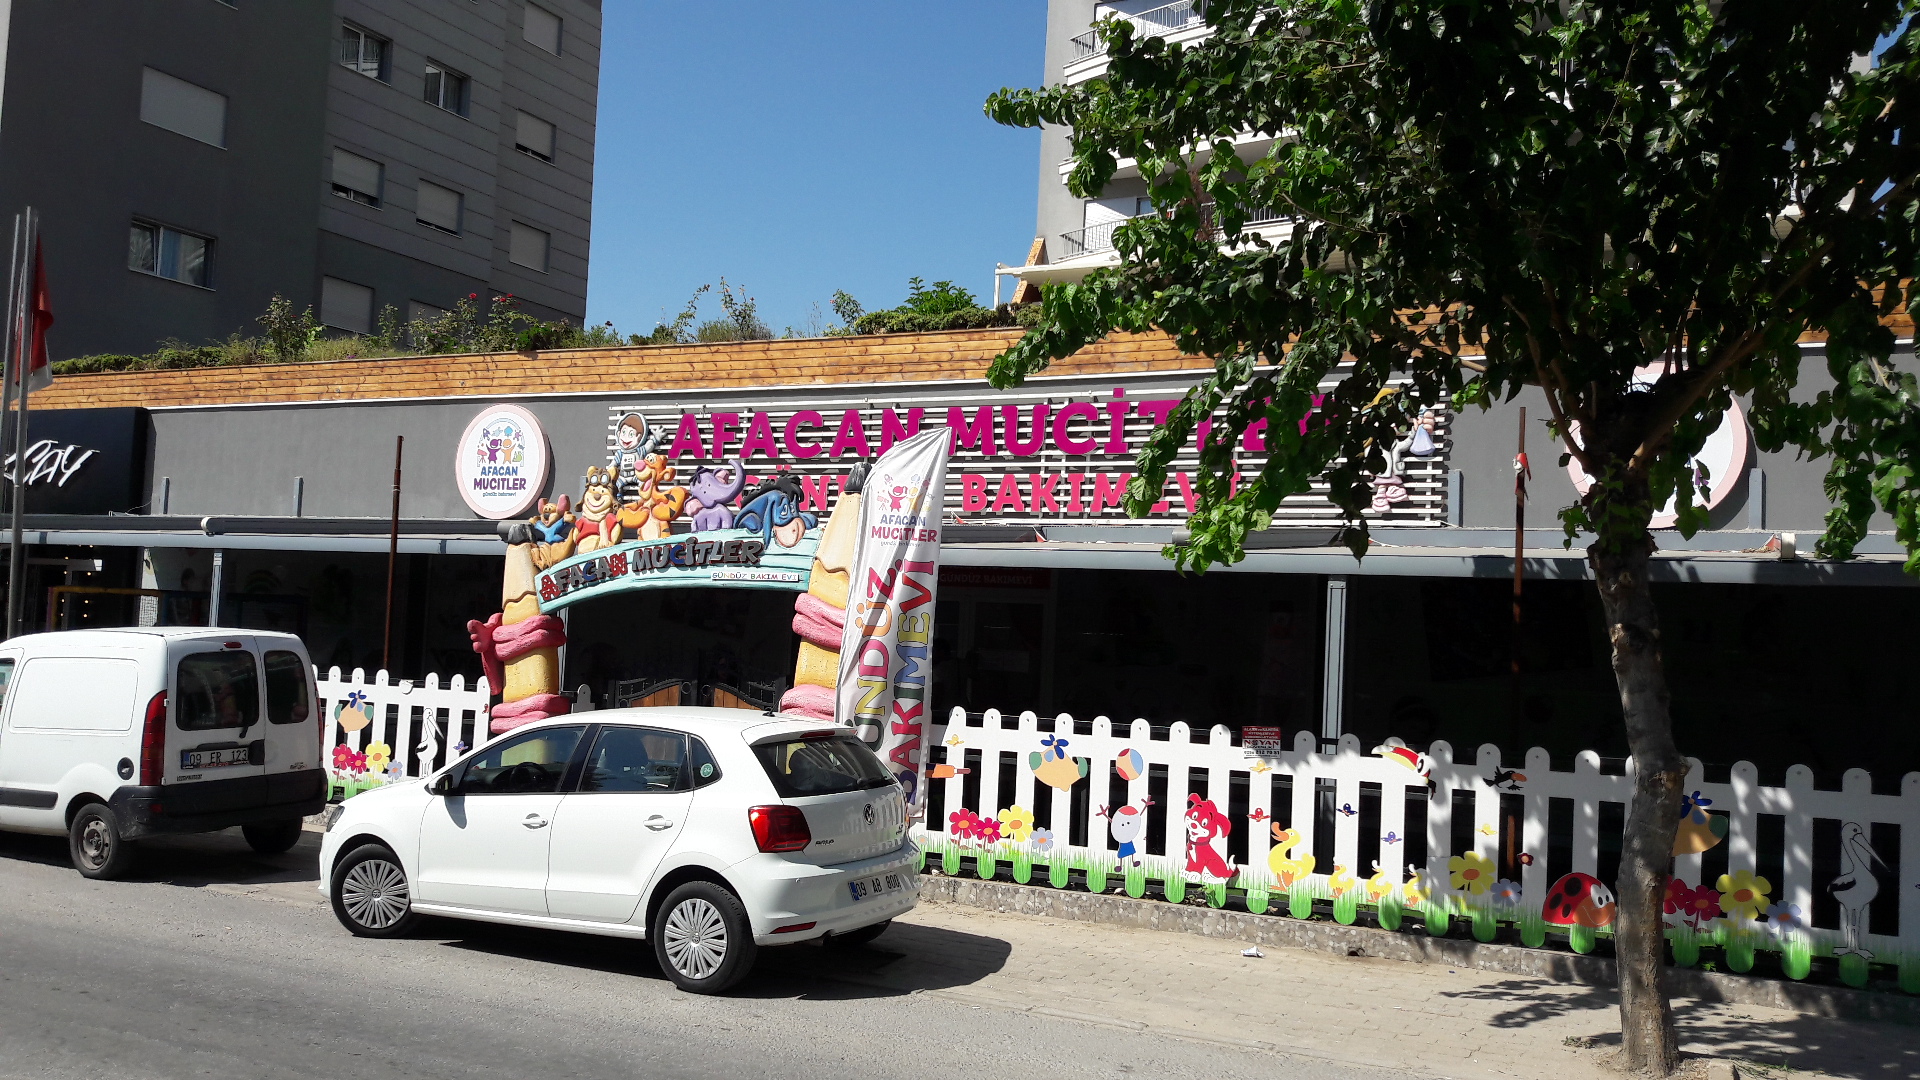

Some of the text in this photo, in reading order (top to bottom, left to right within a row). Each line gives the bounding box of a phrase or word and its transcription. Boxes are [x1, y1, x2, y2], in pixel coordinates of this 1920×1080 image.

[667, 407, 924, 460] AFACAN
[480, 466, 518, 476] AFACAN
[880, 514, 926, 526] AFACAN
[539, 536, 765, 601] AFACAN MUCİTLER
[845, 566, 898, 753] ÜNDÜZ
[1244, 740, 1279, 749] NOYAN
[189, 753, 202, 766] 09
[210, 752, 222, 764] ER
[231, 749, 247, 761] 123
[872, 877, 882, 893] AB
